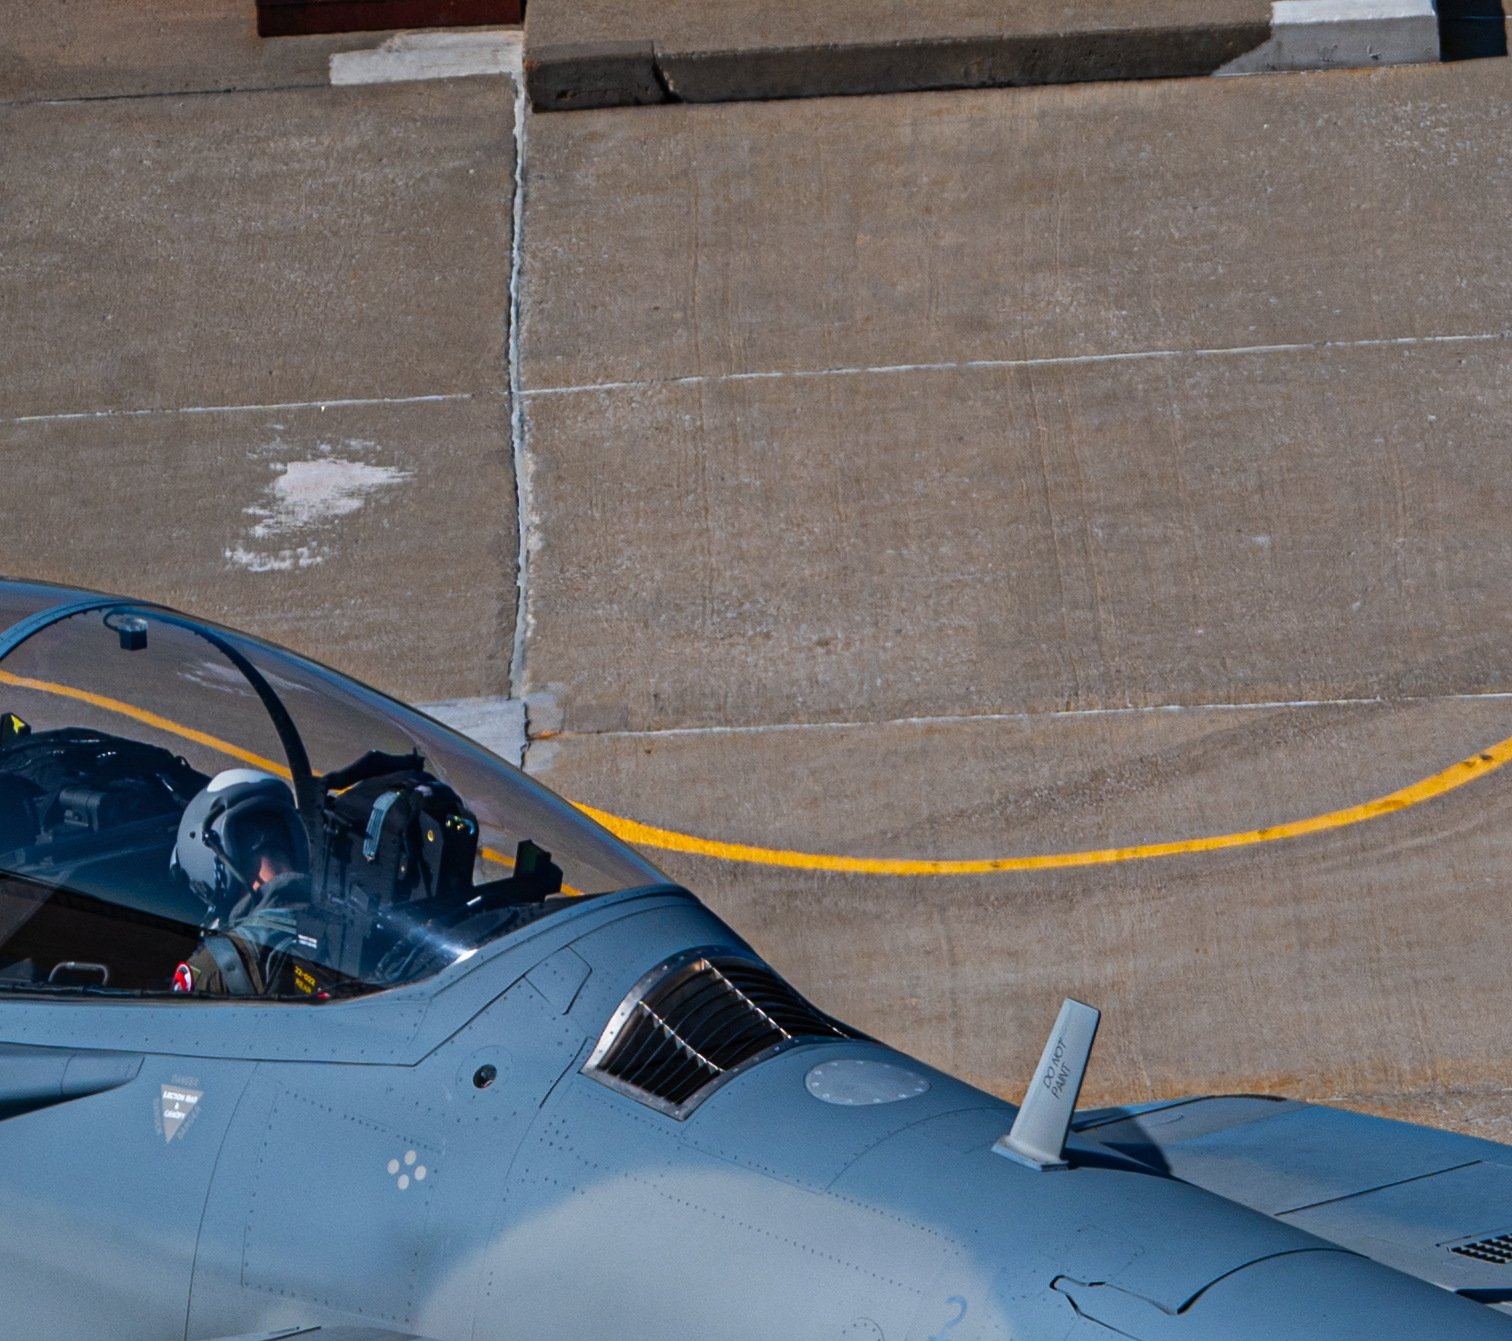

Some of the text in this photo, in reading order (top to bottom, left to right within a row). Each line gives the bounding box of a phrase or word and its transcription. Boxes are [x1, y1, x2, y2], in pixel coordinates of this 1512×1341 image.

[1043, 1037, 1066, 1089] DO NOT
[1051, 1062, 1071, 1100] PAINT
